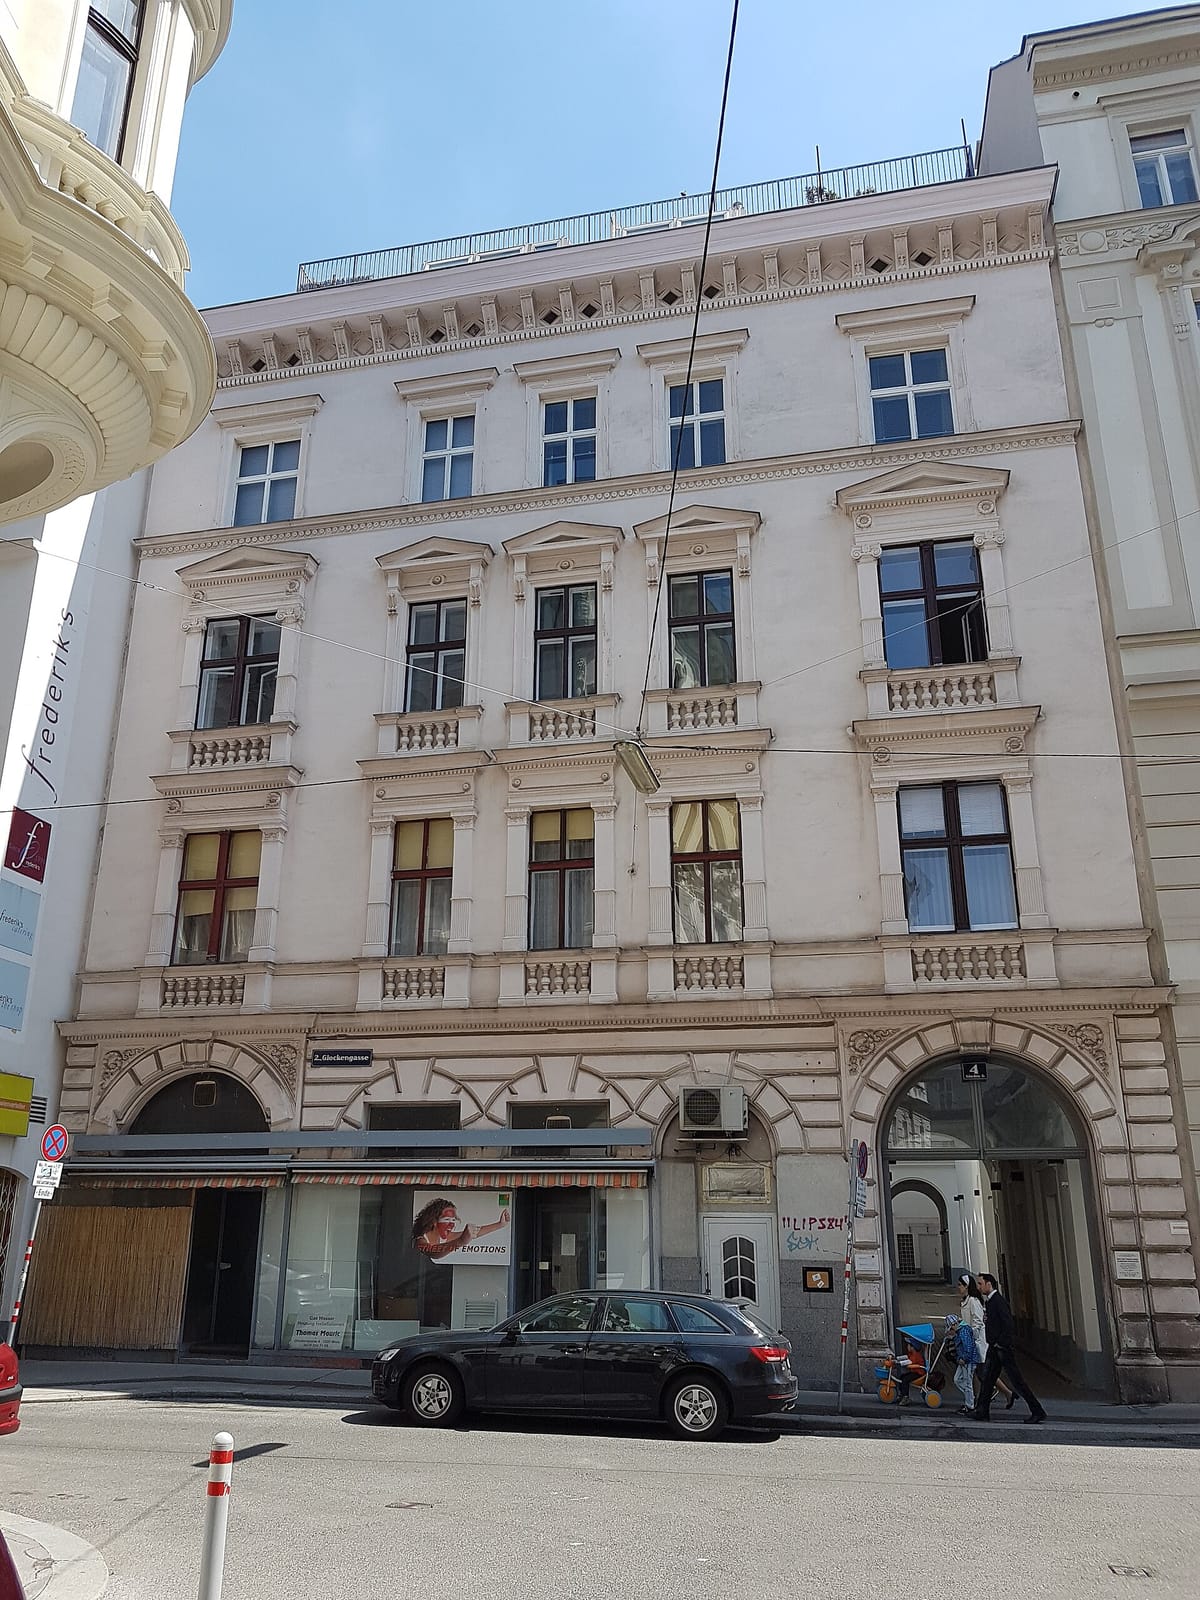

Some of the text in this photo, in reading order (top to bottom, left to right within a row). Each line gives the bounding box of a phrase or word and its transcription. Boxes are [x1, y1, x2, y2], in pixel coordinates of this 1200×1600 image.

[21, 608, 74, 804] frederik's
[322, 1054, 369, 1063] Glockengasse
[969, 1064, 979, 1075] 4
[461, 1245, 507, 1254] EMOTIONS
[295, 1329, 319, 1337] Thomas
